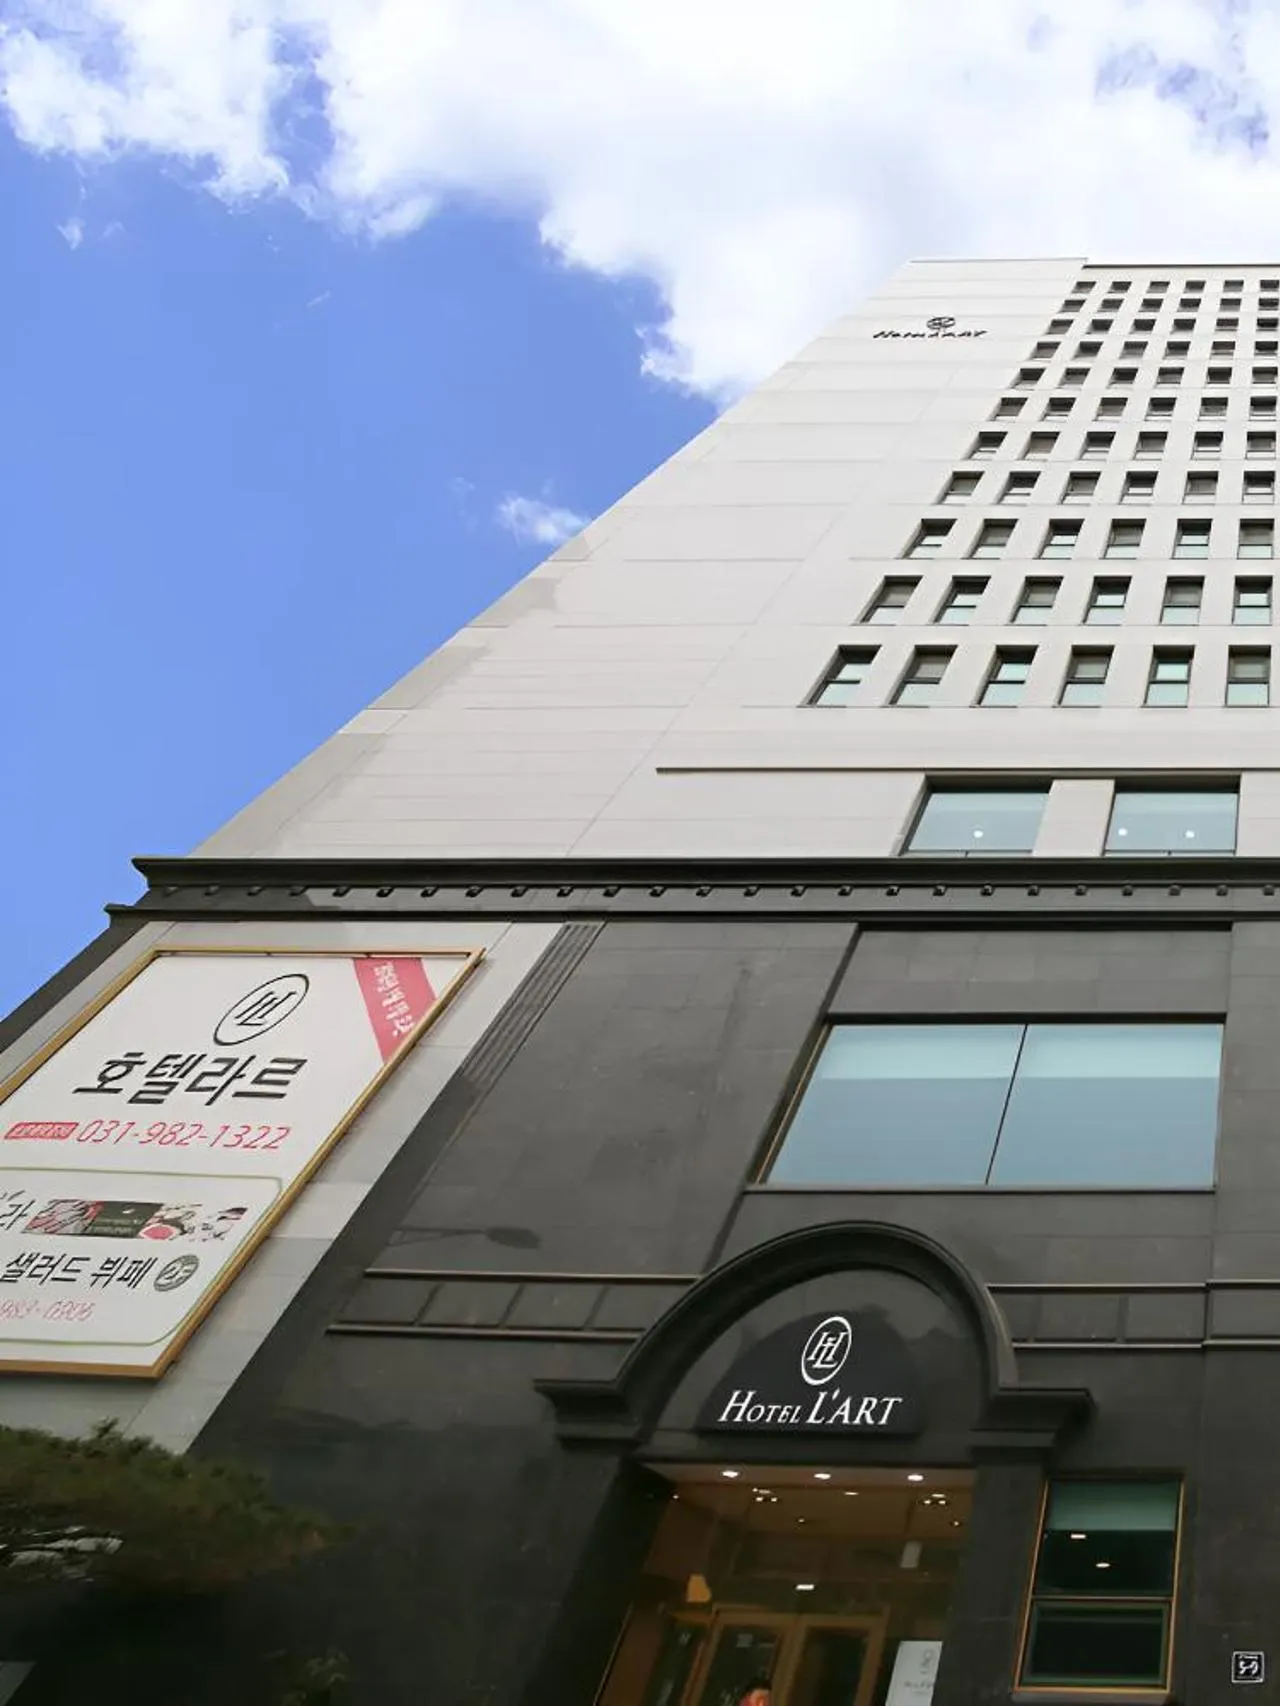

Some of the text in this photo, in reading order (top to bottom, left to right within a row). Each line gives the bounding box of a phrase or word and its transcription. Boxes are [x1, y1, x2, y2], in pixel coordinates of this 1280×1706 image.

[72, 1051, 309, 1107] 호텔라르
[77, 1119, 292, 1151] 031-982-1322
[0, 1252, 158, 1289] 샐러드 뷔페
[717, 1387, 904, 1426] HOTEL L'ART
